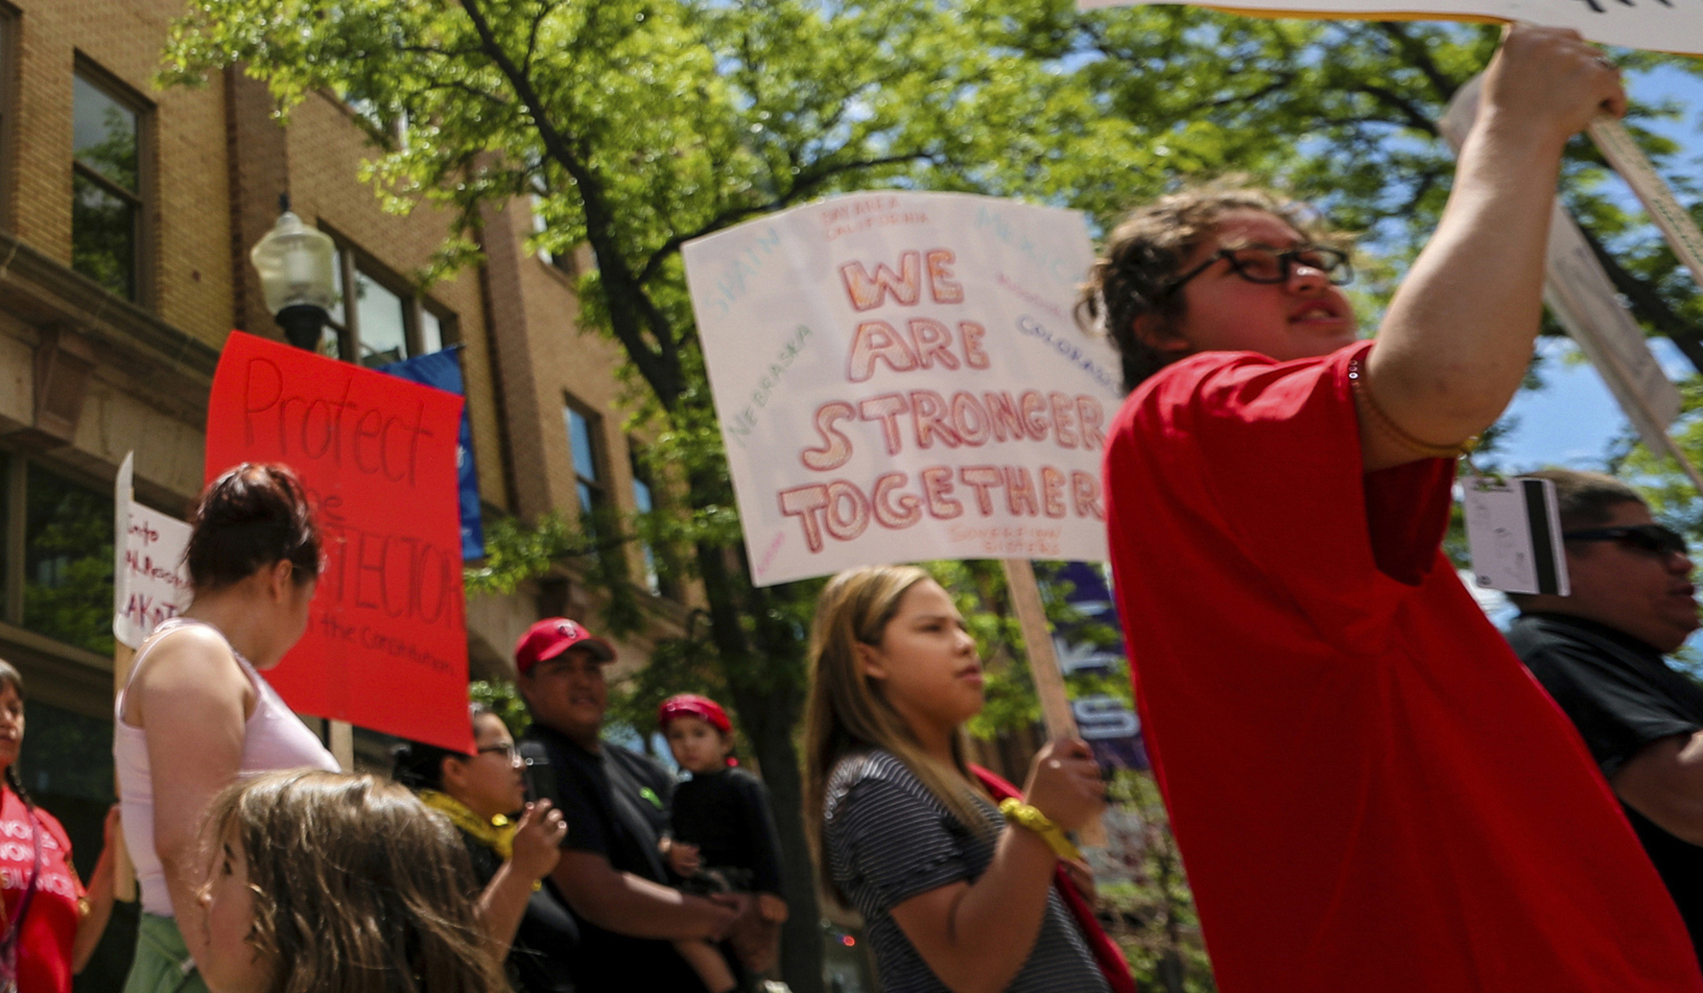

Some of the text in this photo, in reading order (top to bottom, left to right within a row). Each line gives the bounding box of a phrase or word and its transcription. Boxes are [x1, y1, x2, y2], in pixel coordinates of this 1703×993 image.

[839, 248, 965, 313] WE
[848, 316, 992, 384] ARE
[245, 356, 434, 488] Protect
[800, 389, 1107, 472] STRONGER
[778, 465, 1107, 553] TOGETHER
